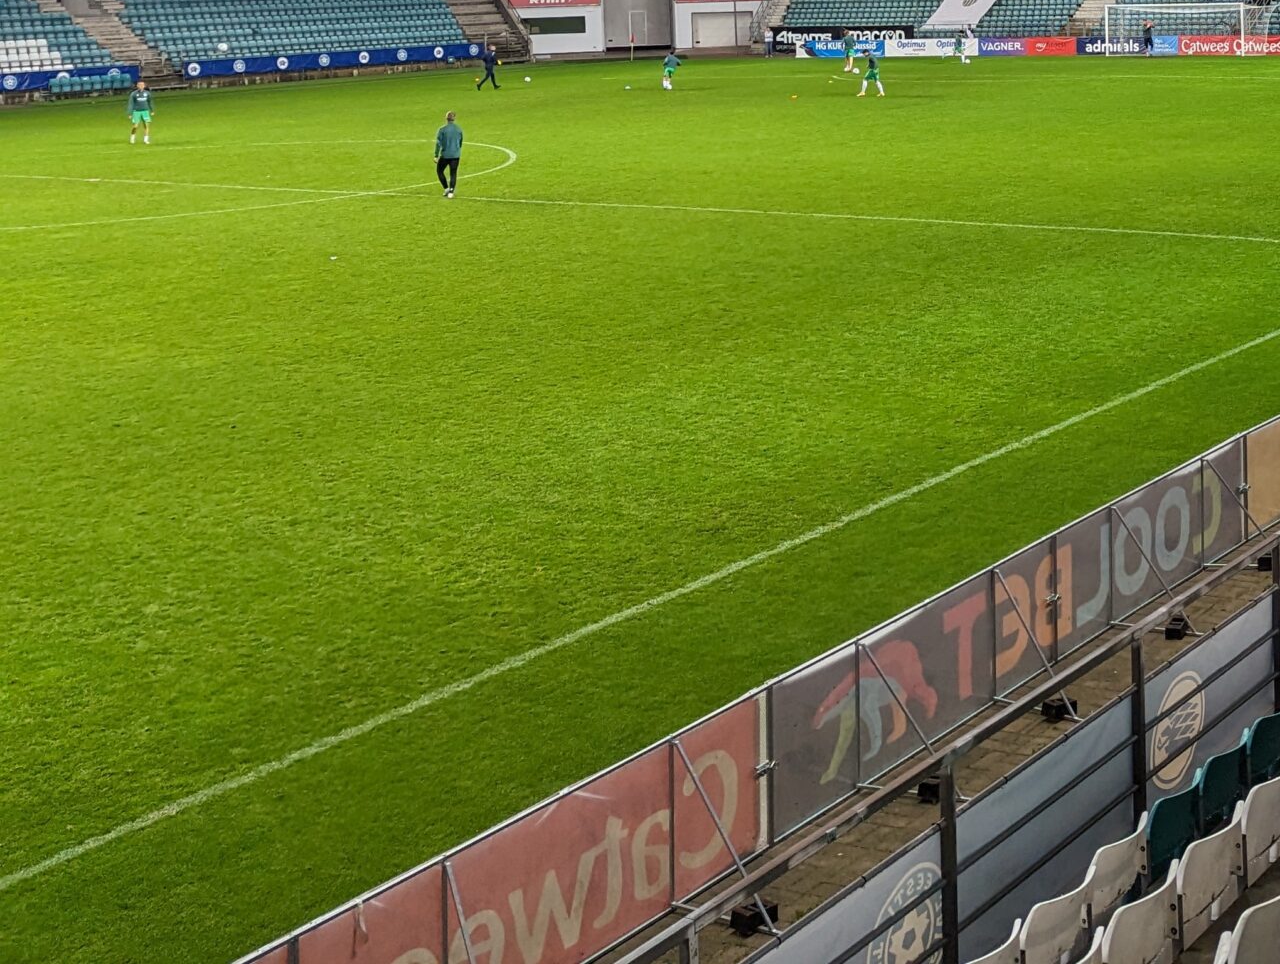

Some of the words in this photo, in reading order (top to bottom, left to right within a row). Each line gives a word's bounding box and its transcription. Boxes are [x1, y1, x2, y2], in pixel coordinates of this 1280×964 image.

[815, 41, 827, 51] HG
[896, 40, 927, 50] Optimus
[980, 41, 1025, 51] VAGNER.
[1085, 38, 1140, 53] admirals
[1181, 39, 1229, 53] Catwees
